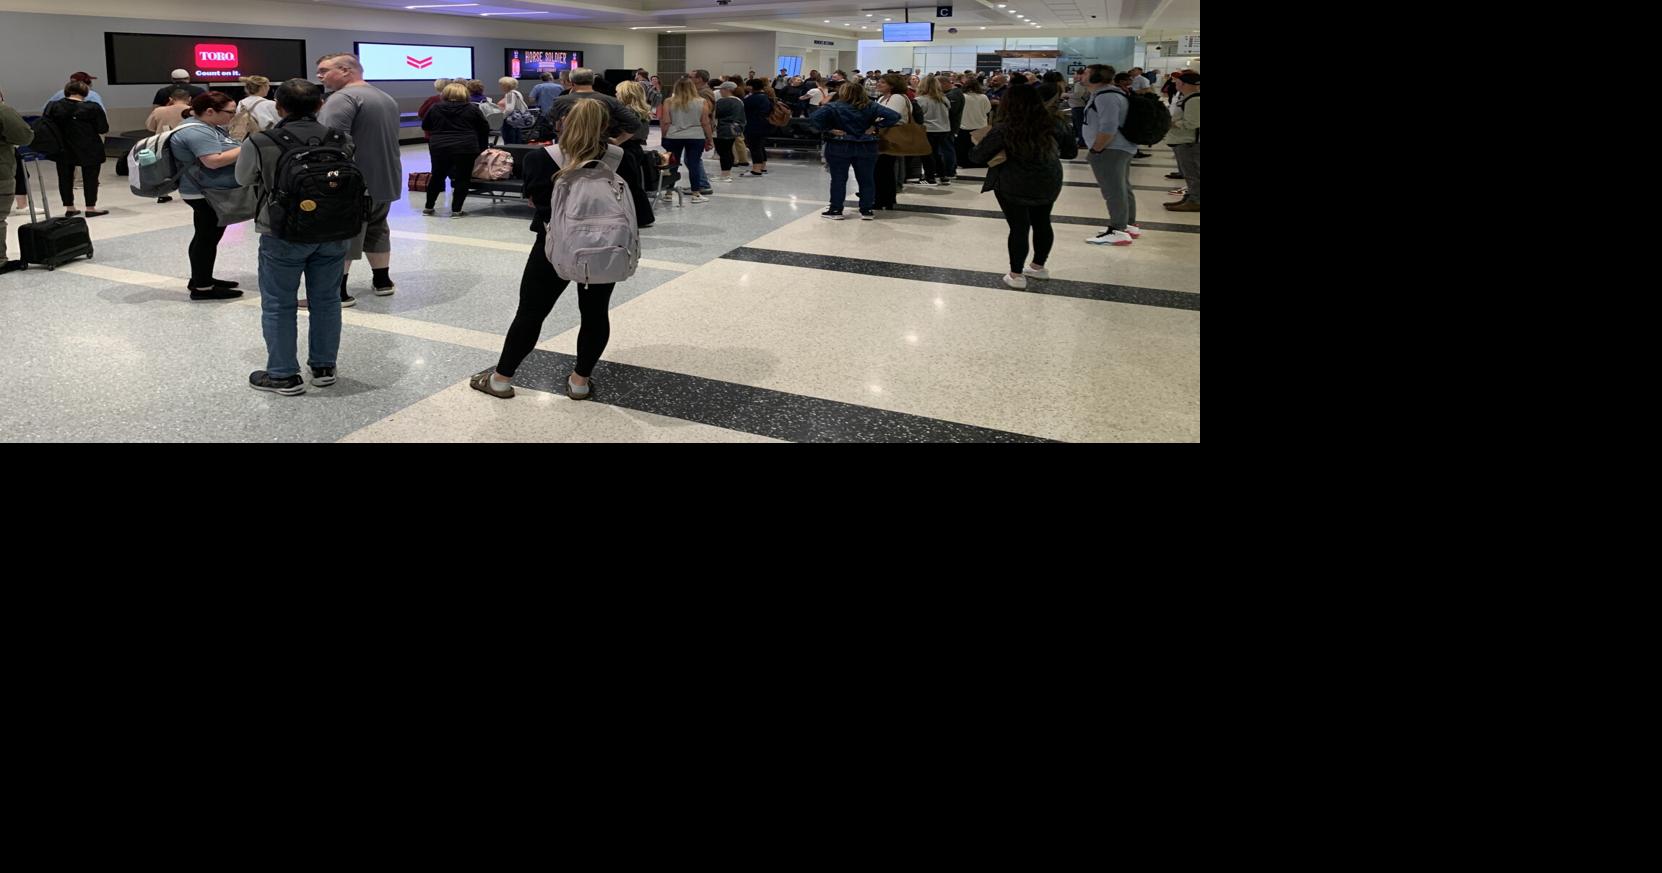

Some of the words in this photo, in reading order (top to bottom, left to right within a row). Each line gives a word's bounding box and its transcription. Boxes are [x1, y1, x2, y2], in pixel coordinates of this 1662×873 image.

[940, 8, 949, 16] C
[199, 51, 235, 61] TORO
[525, 50, 543, 63] HORSE
